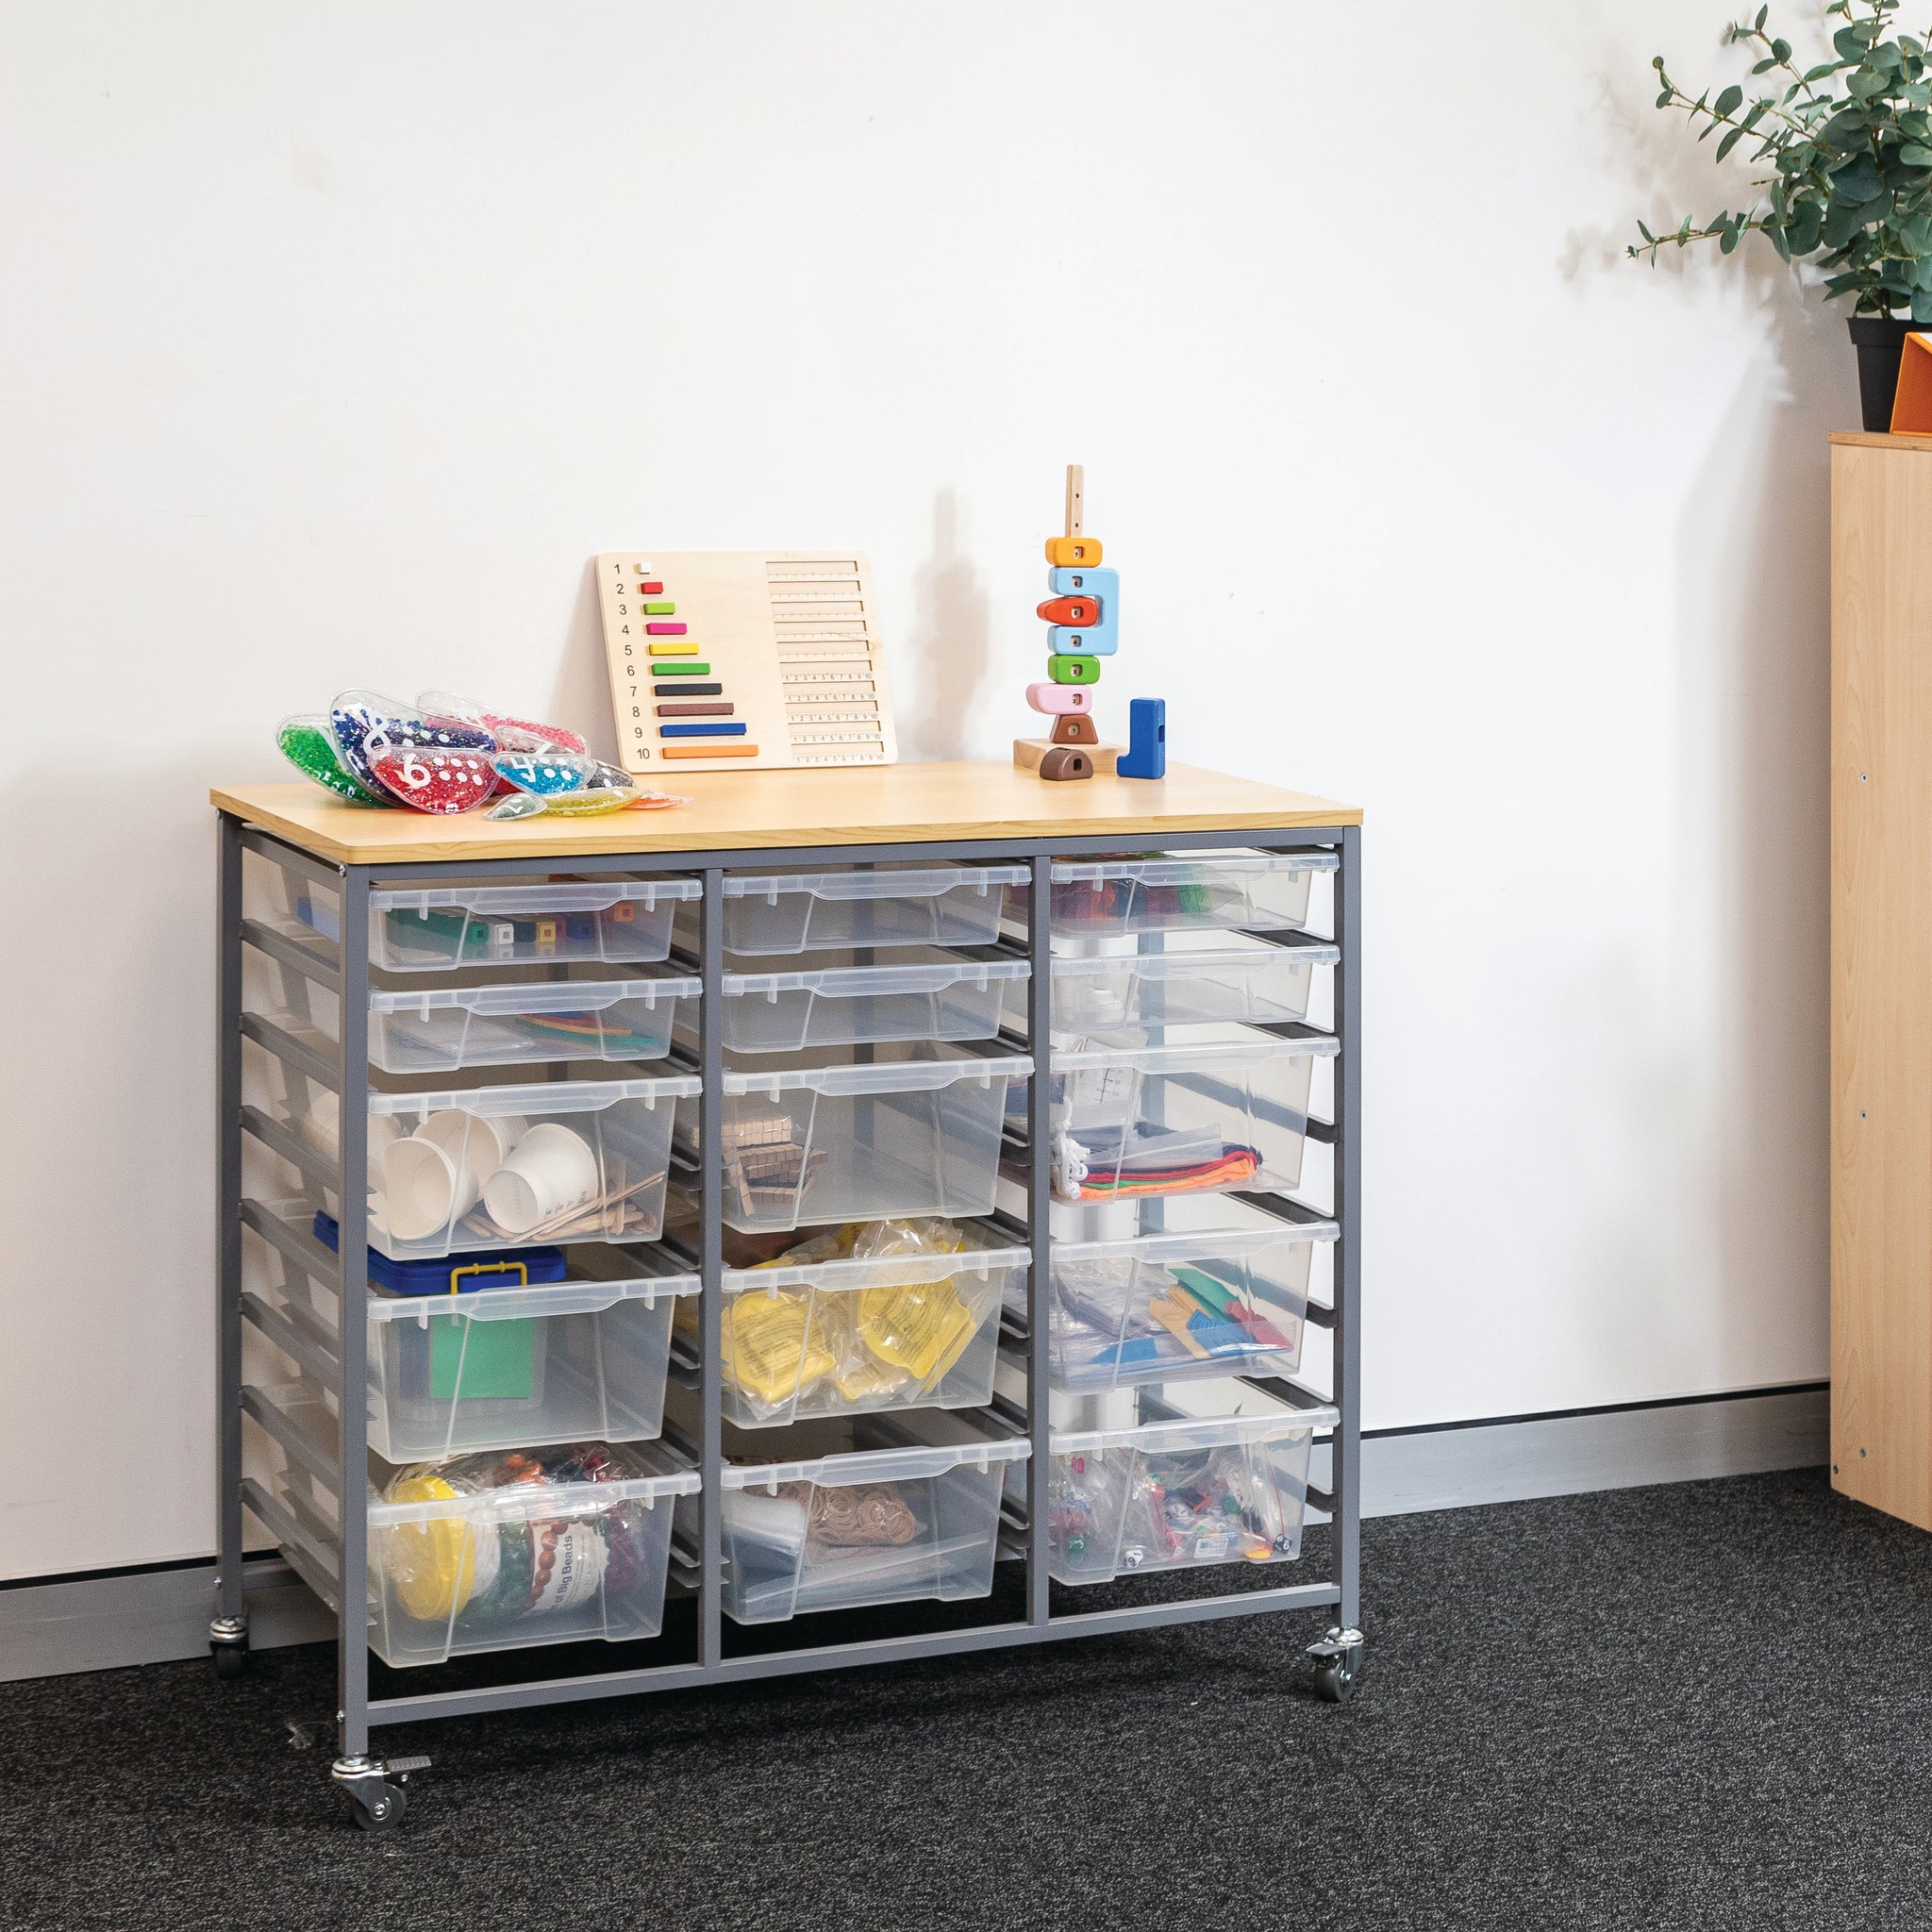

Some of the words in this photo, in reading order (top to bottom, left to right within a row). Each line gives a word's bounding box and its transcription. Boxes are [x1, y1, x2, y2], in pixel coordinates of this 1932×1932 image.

[614, 563, 621, 575] 1
[616, 583, 625, 594] 2
[619, 604, 627, 615] 3
[622, 625, 630, 635] 4
[625, 644, 633, 656] 5
[626, 664, 635, 676] 6
[629, 686, 637, 697] 7
[632, 706, 641, 718] 8
[363, 711, 391, 755] 8
[634, 726, 642, 739] 9
[636, 747, 650, 759] 10
[404, 754, 431, 788] 6
[561, 1535, 573, 1574] Beads
[558, 1575, 573, 1593] Big
